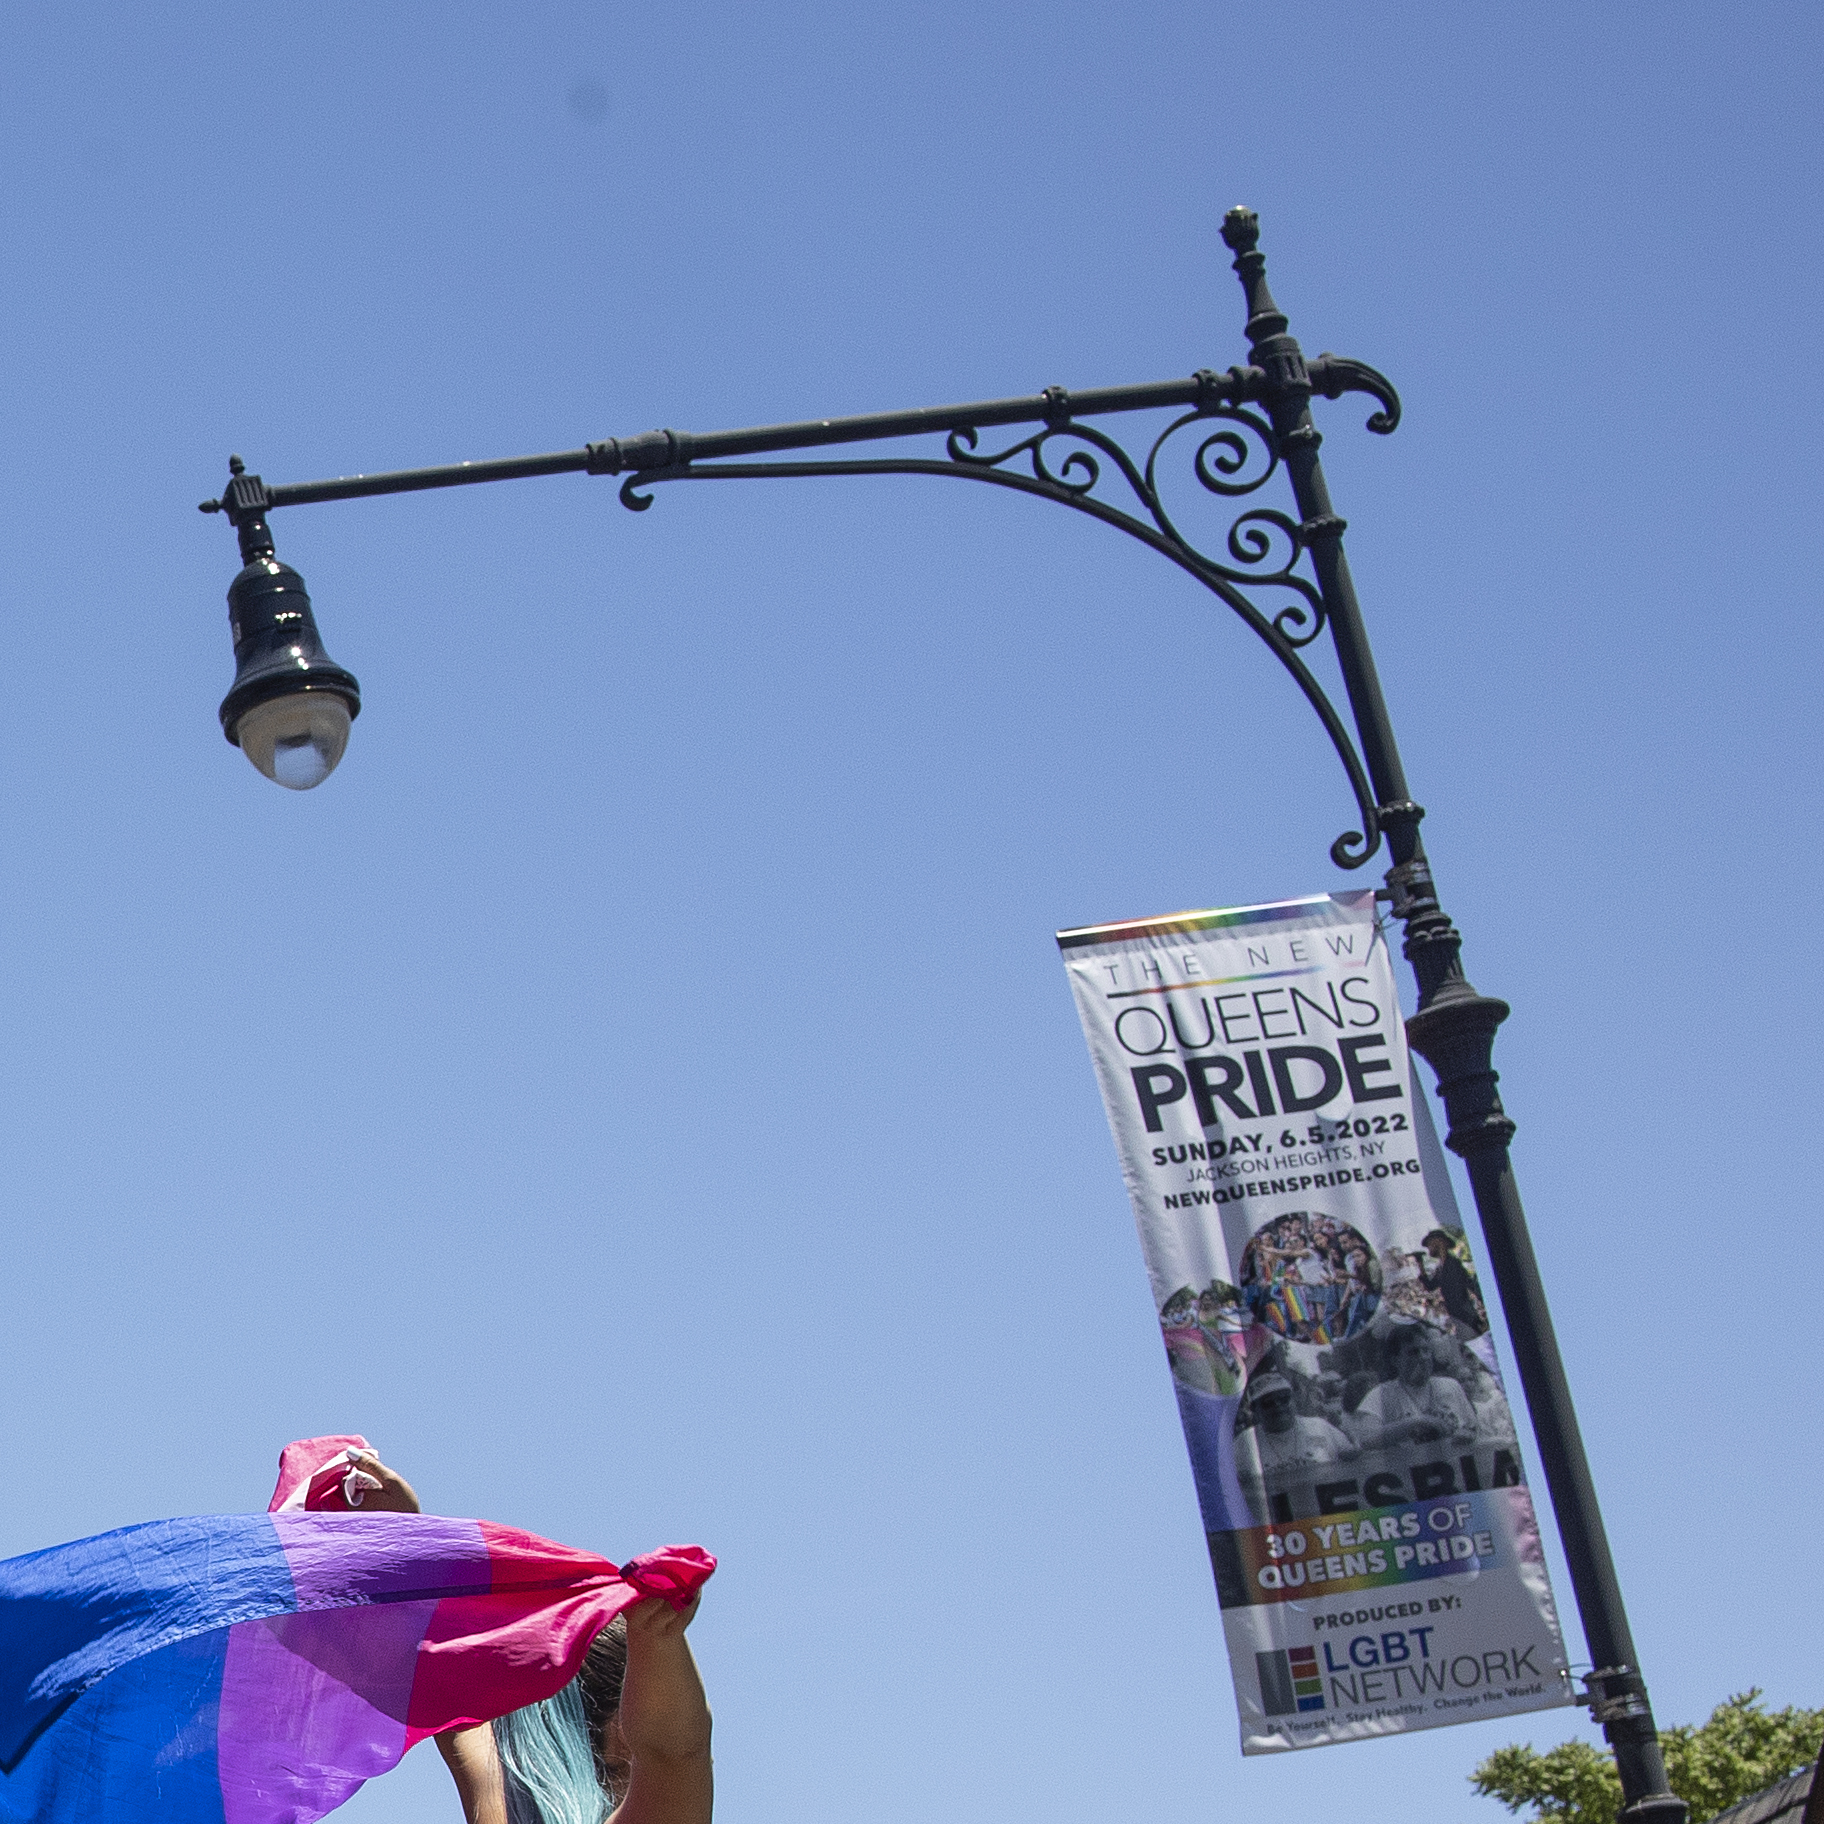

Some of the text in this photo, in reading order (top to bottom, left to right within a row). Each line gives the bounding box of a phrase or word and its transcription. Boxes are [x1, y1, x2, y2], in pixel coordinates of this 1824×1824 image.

[1103, 934, 1354, 985] THE NEW
[1114, 976, 1380, 1056] QUEENS
[1130, 1033, 1404, 1133] PRIDE
[1152, 1112, 1409, 1167] SUNDAY, 6.5.2022
[1187, 1140, 1387, 1183] JACKSON HEIGHTS, NY
[1163, 1158, 1421, 1210] NEWQUEENSPRIDE.ORG
[1266, 1502, 1473, 1559] 30 YEARS OF
[1257, 1529, 1496, 1591] QUEENS PRIDE
[1312, 1595, 1463, 1631] PRODUCED BY:
[1323, 1625, 1435, 1674] LGBT
[1329, 1643, 1541, 1709] NETWORK
[1433, 1694, 1481, 1711] Change
